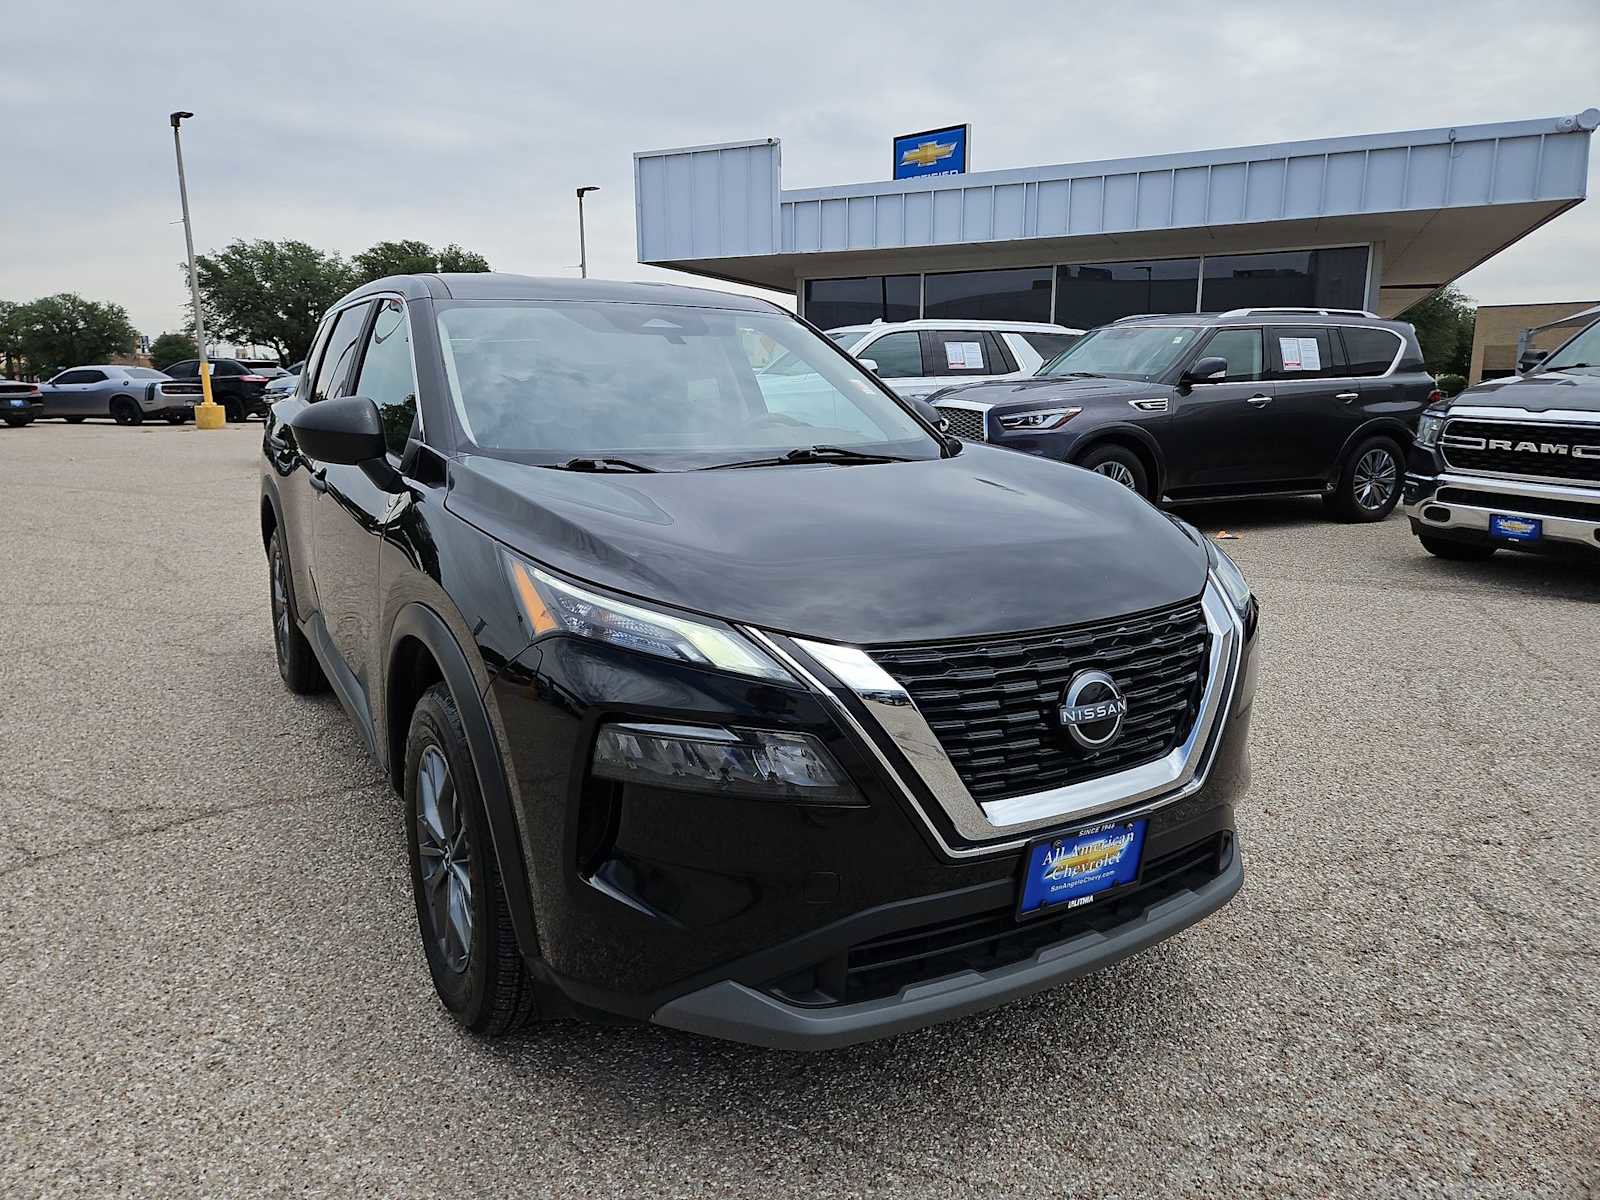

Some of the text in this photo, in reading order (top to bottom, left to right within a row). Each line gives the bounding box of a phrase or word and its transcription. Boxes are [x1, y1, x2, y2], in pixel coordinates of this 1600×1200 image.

[1488, 439, 1569, 455] RAM
[1062, 700, 1126, 723] NISSAN
[1078, 826, 1101, 837] SINCE
[1041, 832, 1135, 866] All American
[1052, 852, 1121, 880] Chevrolet
[1050, 870, 1116, 893] SanAngeloChevy.com
